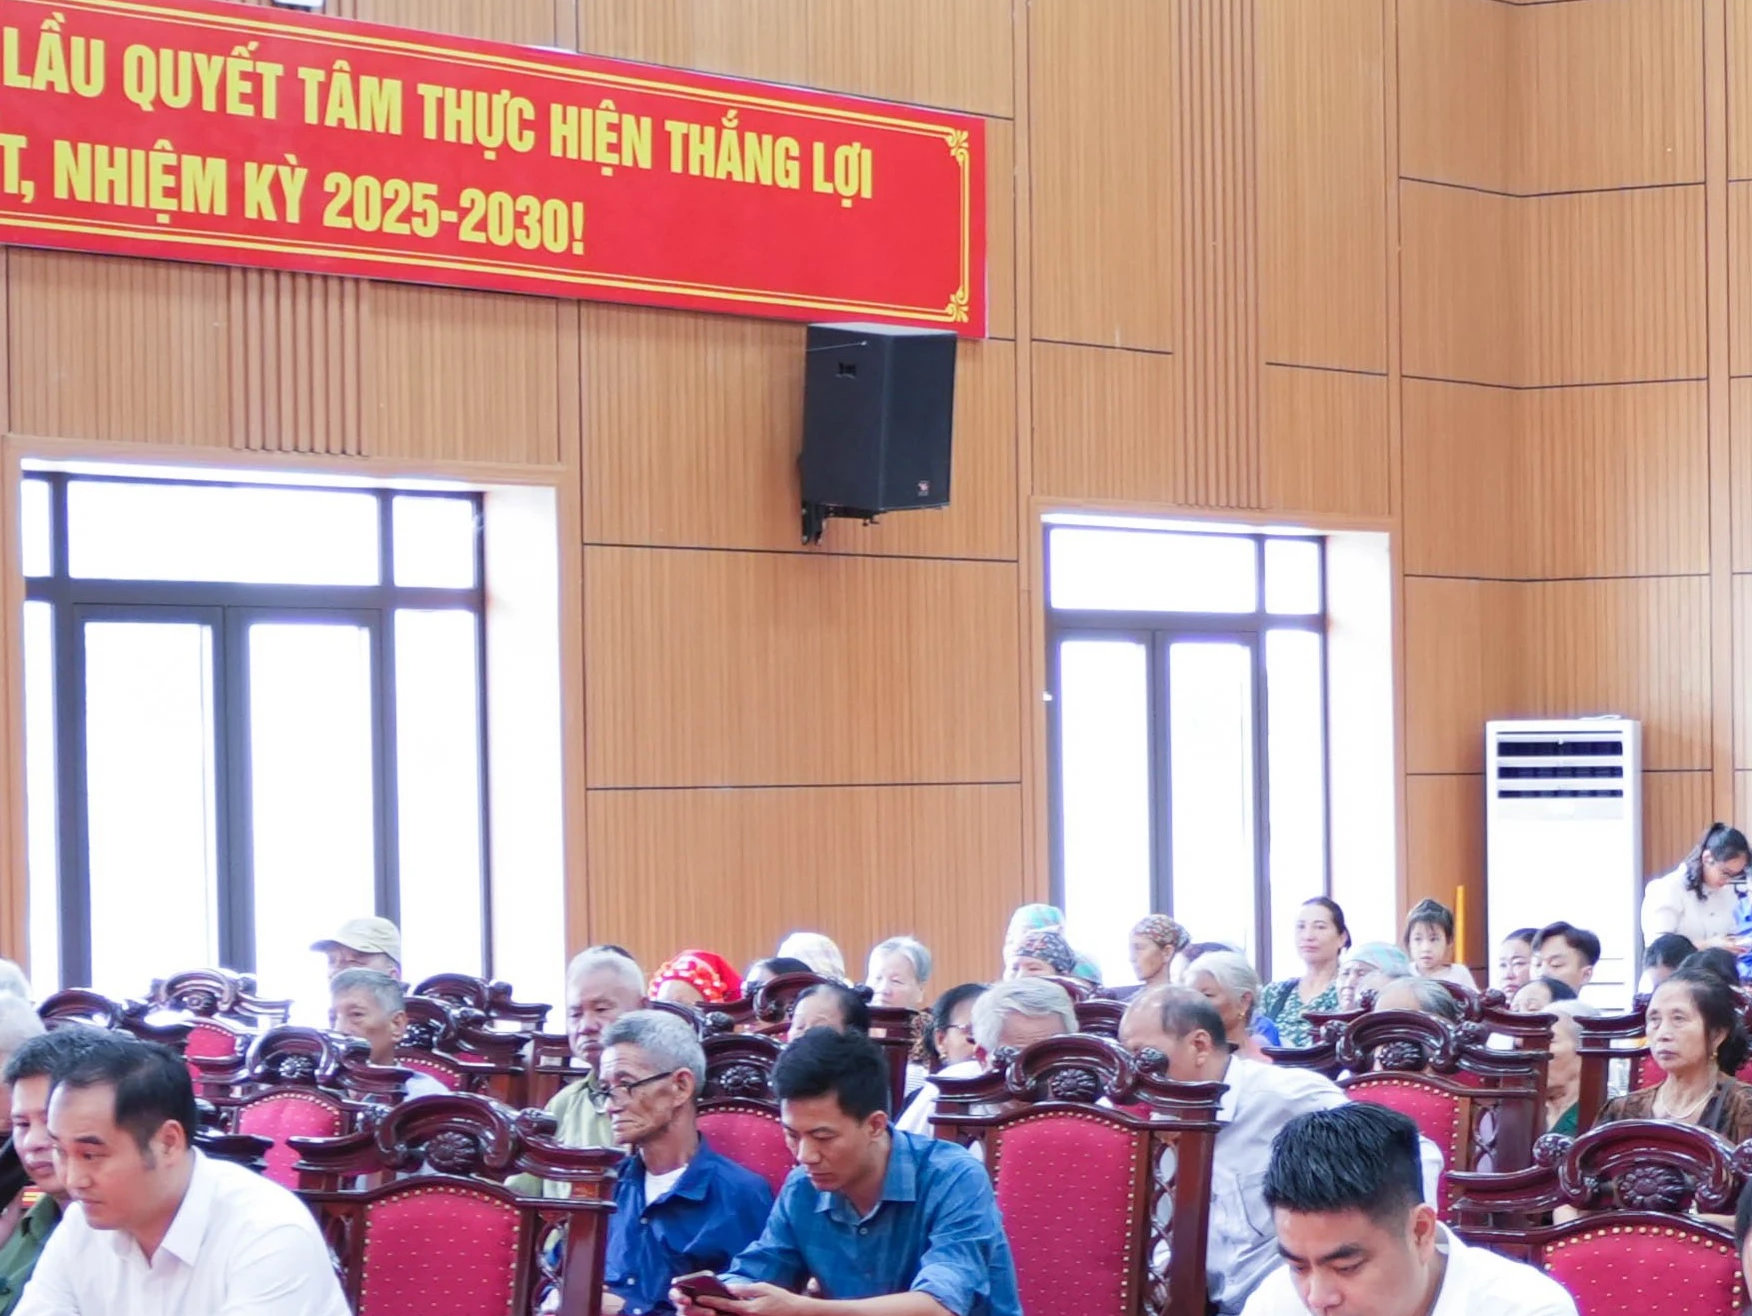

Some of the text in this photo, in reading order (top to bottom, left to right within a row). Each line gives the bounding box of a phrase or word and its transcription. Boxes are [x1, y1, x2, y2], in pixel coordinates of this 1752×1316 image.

[4, 11, 104, 96] LẦU
[124, 41, 282, 118] QUYẾT
[300, 59, 402, 133] TÂM
[418, 84, 535, 160] THỰC
[551, 99, 652, 171] HIỆN
[666, 108, 800, 188] THẮNG
[813, 140, 872, 207] LỢI
[54, 138, 227, 224] NHIỆM
[245, 154, 307, 221] KỲ
[324, 172, 584, 254] 2025-2030!
